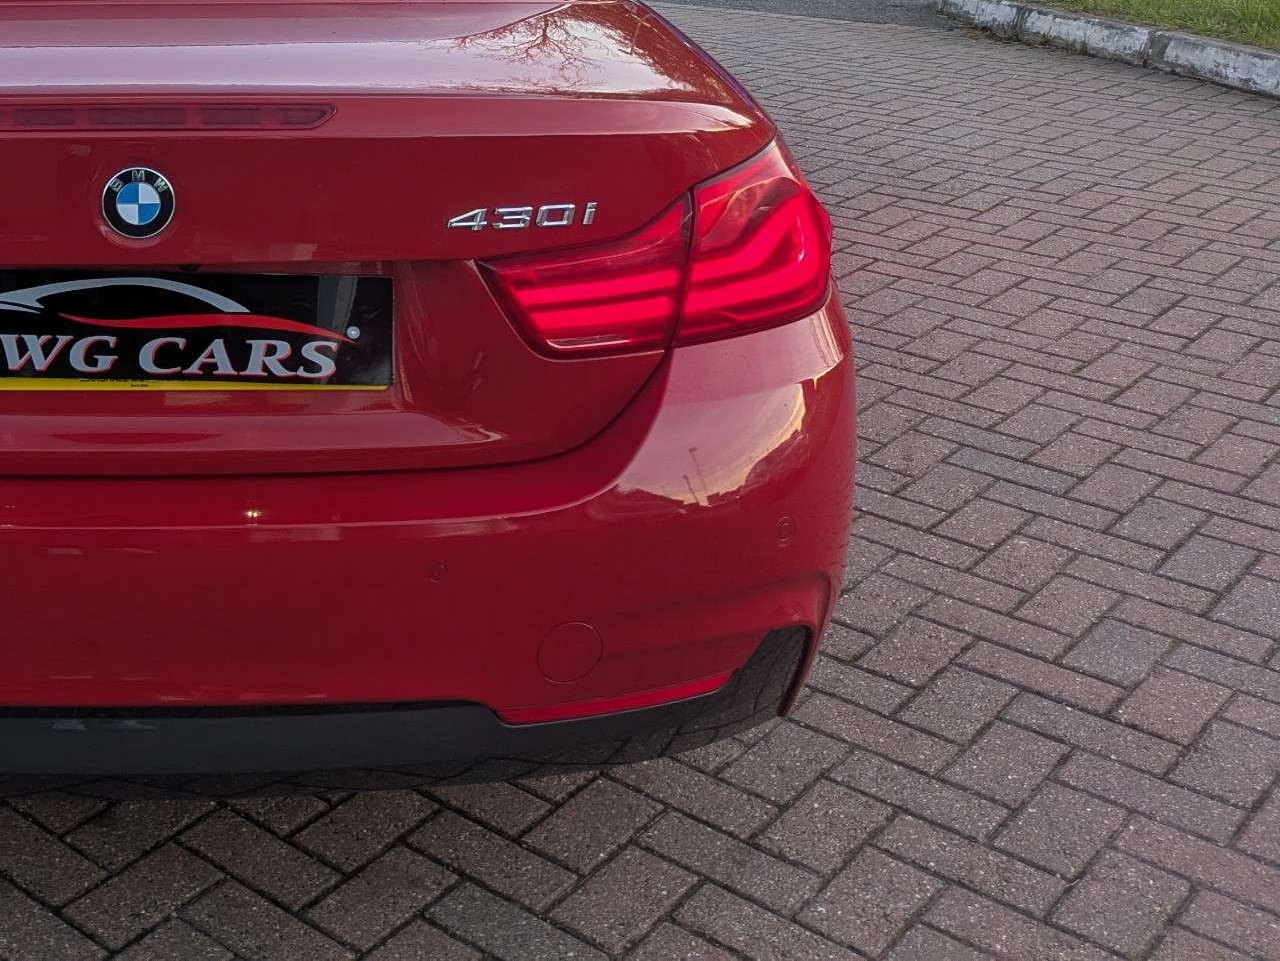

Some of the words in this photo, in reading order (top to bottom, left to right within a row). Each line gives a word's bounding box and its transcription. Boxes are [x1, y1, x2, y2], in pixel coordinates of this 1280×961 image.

[109, 169, 169, 192] BMW
[447, 201, 598, 231] 430i
[138, 336, 341, 379] CARS
